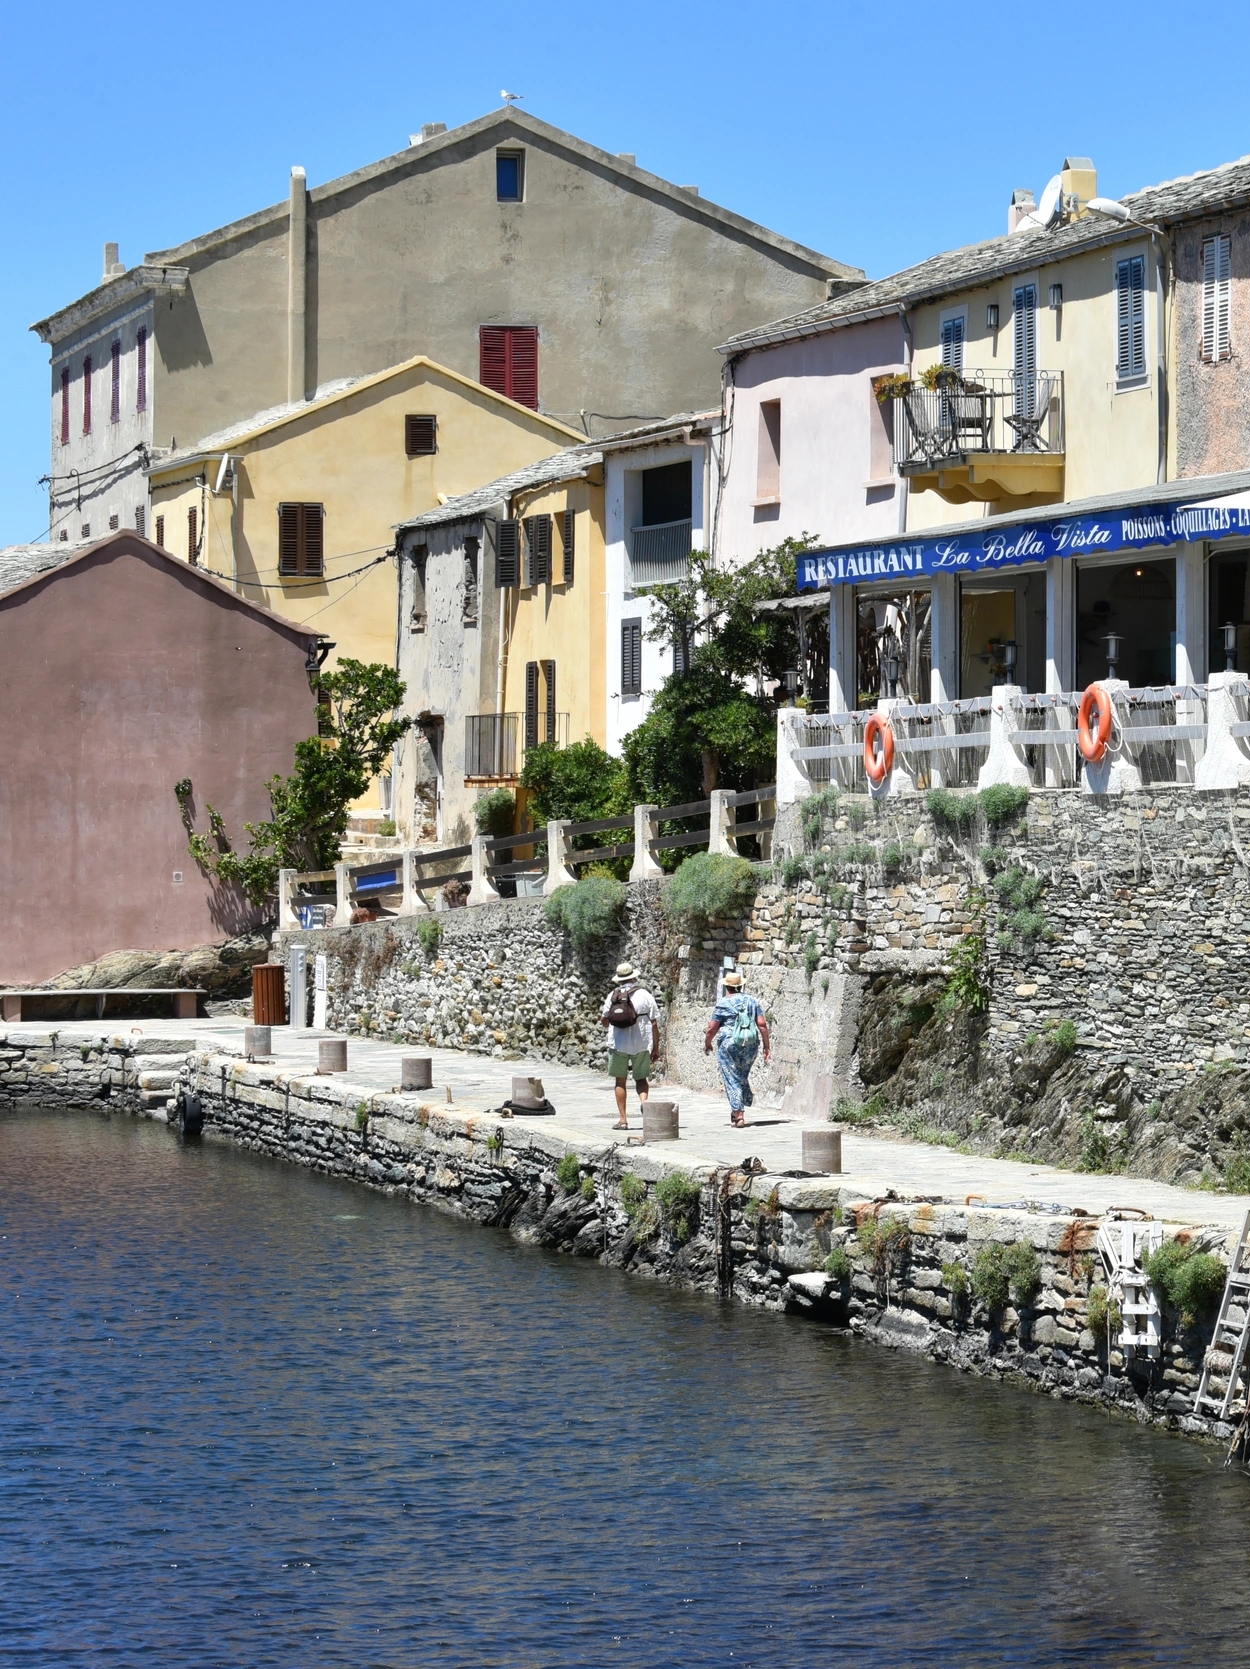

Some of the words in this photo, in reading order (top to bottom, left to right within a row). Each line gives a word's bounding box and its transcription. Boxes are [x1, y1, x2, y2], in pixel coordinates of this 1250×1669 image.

[804, 545, 924, 582] RESTAURANT
[931, 539, 971, 567] La
[976, 529, 1045, 562] Bella
[1051, 521, 1112, 551] Vista
[1122, 515, 1165, 541] POISSONS
[1171, 508, 1230, 541] COQUILLAGES
